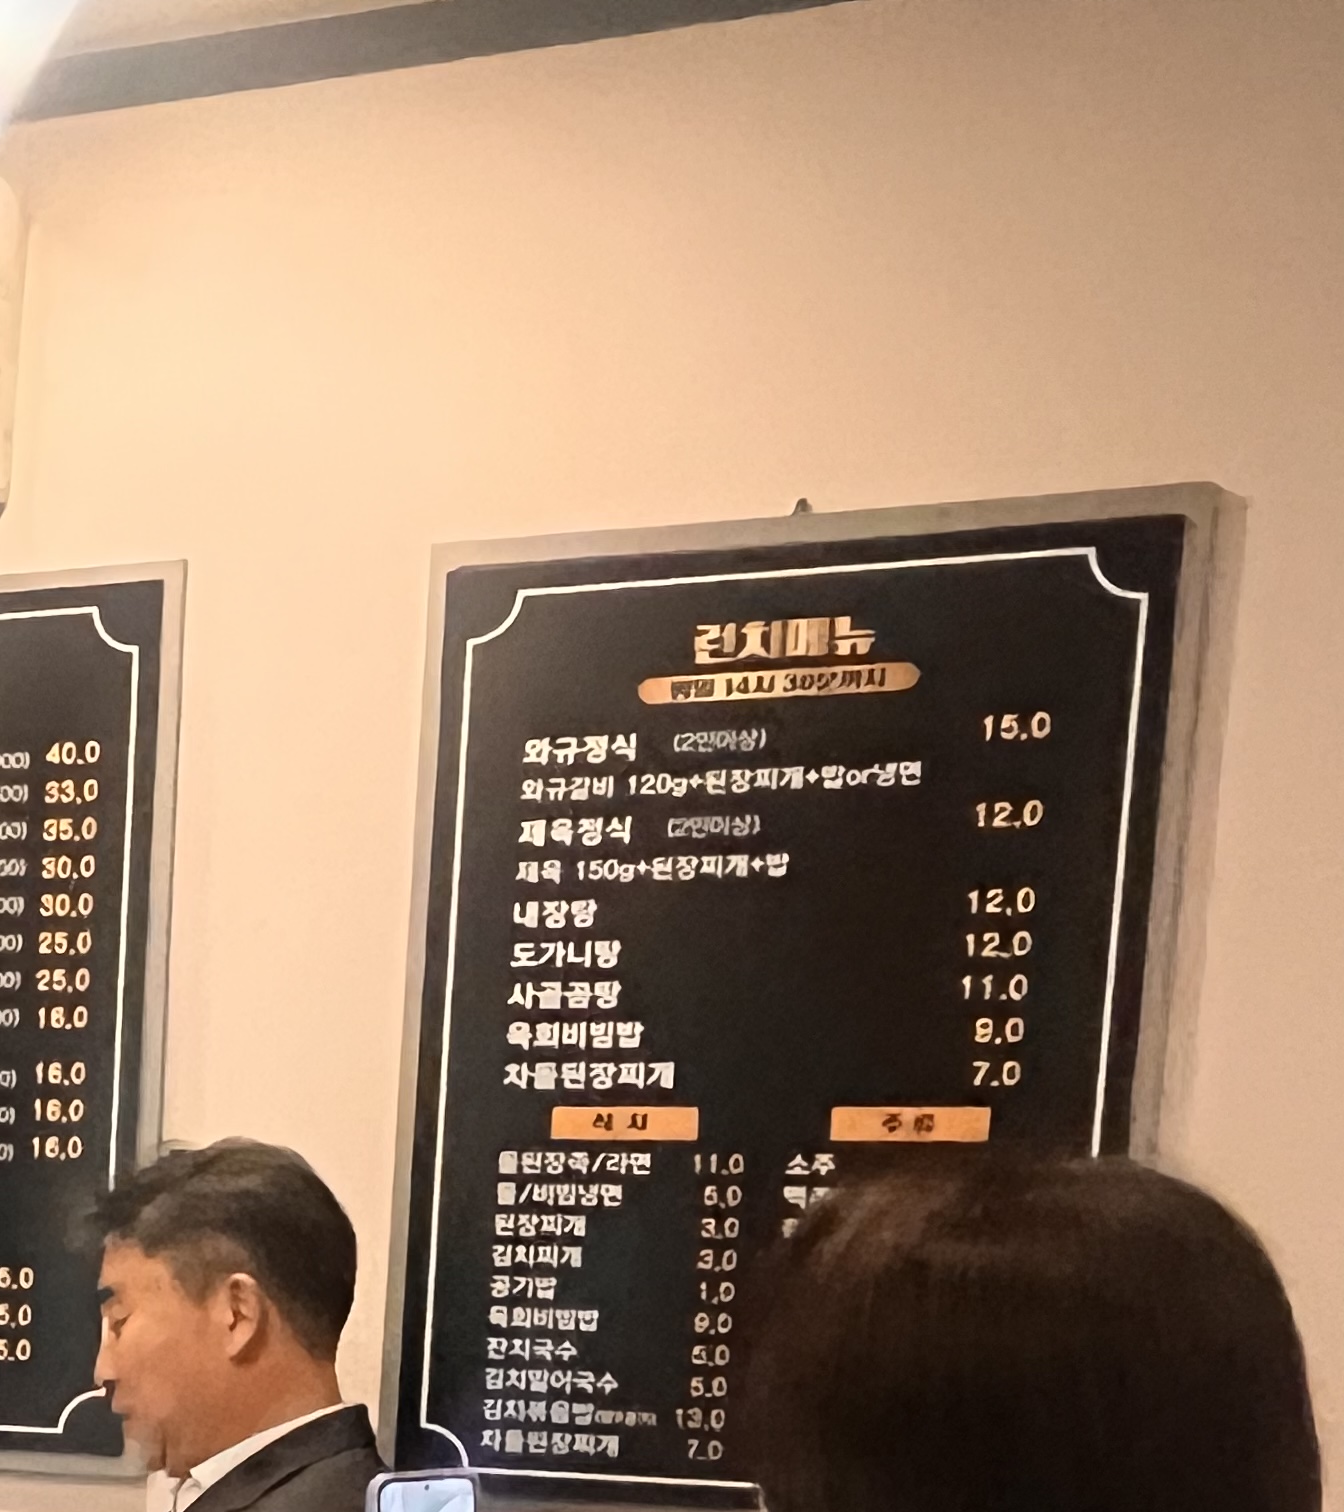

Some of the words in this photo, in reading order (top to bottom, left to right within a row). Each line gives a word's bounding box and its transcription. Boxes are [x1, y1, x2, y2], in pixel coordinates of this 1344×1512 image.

[693, 614, 876, 665] 런치메뉴
[523, 733, 636, 765] 와규정식
[674, 728, 766, 752] (2인이상)
[984, 712, 1050, 741] 15.0
[46, 741, 100, 764] 40.0
[45, 779, 98, 804] 33.0
[521, 776, 614, 802] 와규갈비
[43, 817, 97, 841] 35.0
[518, 816, 632, 846] 제육정식
[976, 800, 1043, 828] 12.0
[42, 855, 95, 879] 30.0
[516, 860, 561, 884] 제육
[40, 893, 93, 918] 30.0
[513, 899, 597, 928] 내장탕
[968, 887, 1035, 916] 12.0
[39, 930, 91, 955] 25.0
[510, 940, 621, 968] 도가니탕
[966, 931, 1032, 958] 12.0
[36, 968, 90, 993] 25.0
[507, 981, 621, 1009] 사골곰탕
[962, 974, 1027, 1000] 11.0
[507, 1021, 644, 1050] 육회비빔밥
[36, 1062, 85, 1085] 16.0
[503, 1061, 674, 1089] 차돌된장찌개
[973, 1061, 1020, 1086] 7.0
[33, 1136, 82, 1160] 16.0
[785, 1154, 835, 1175] 소주
[495, 1214, 586, 1236] 된장찌개
[701, 1218, 739, 1239] 3.0
[492, 1245, 582, 1268] 김치찌개
[697, 1249, 737, 1271] 3.0
[490, 1275, 557, 1300] 공기밥
[700, 1282, 735, 1304] 1.0
[489, 1306, 599, 1331] 육회비빔밥
[487, 1338, 577, 1361] 잔치국수
[486, 1368, 618, 1394] 김치말이국수
[691, 1377, 727, 1397] 5.0
[688, 1439, 723, 1460] 7.0
